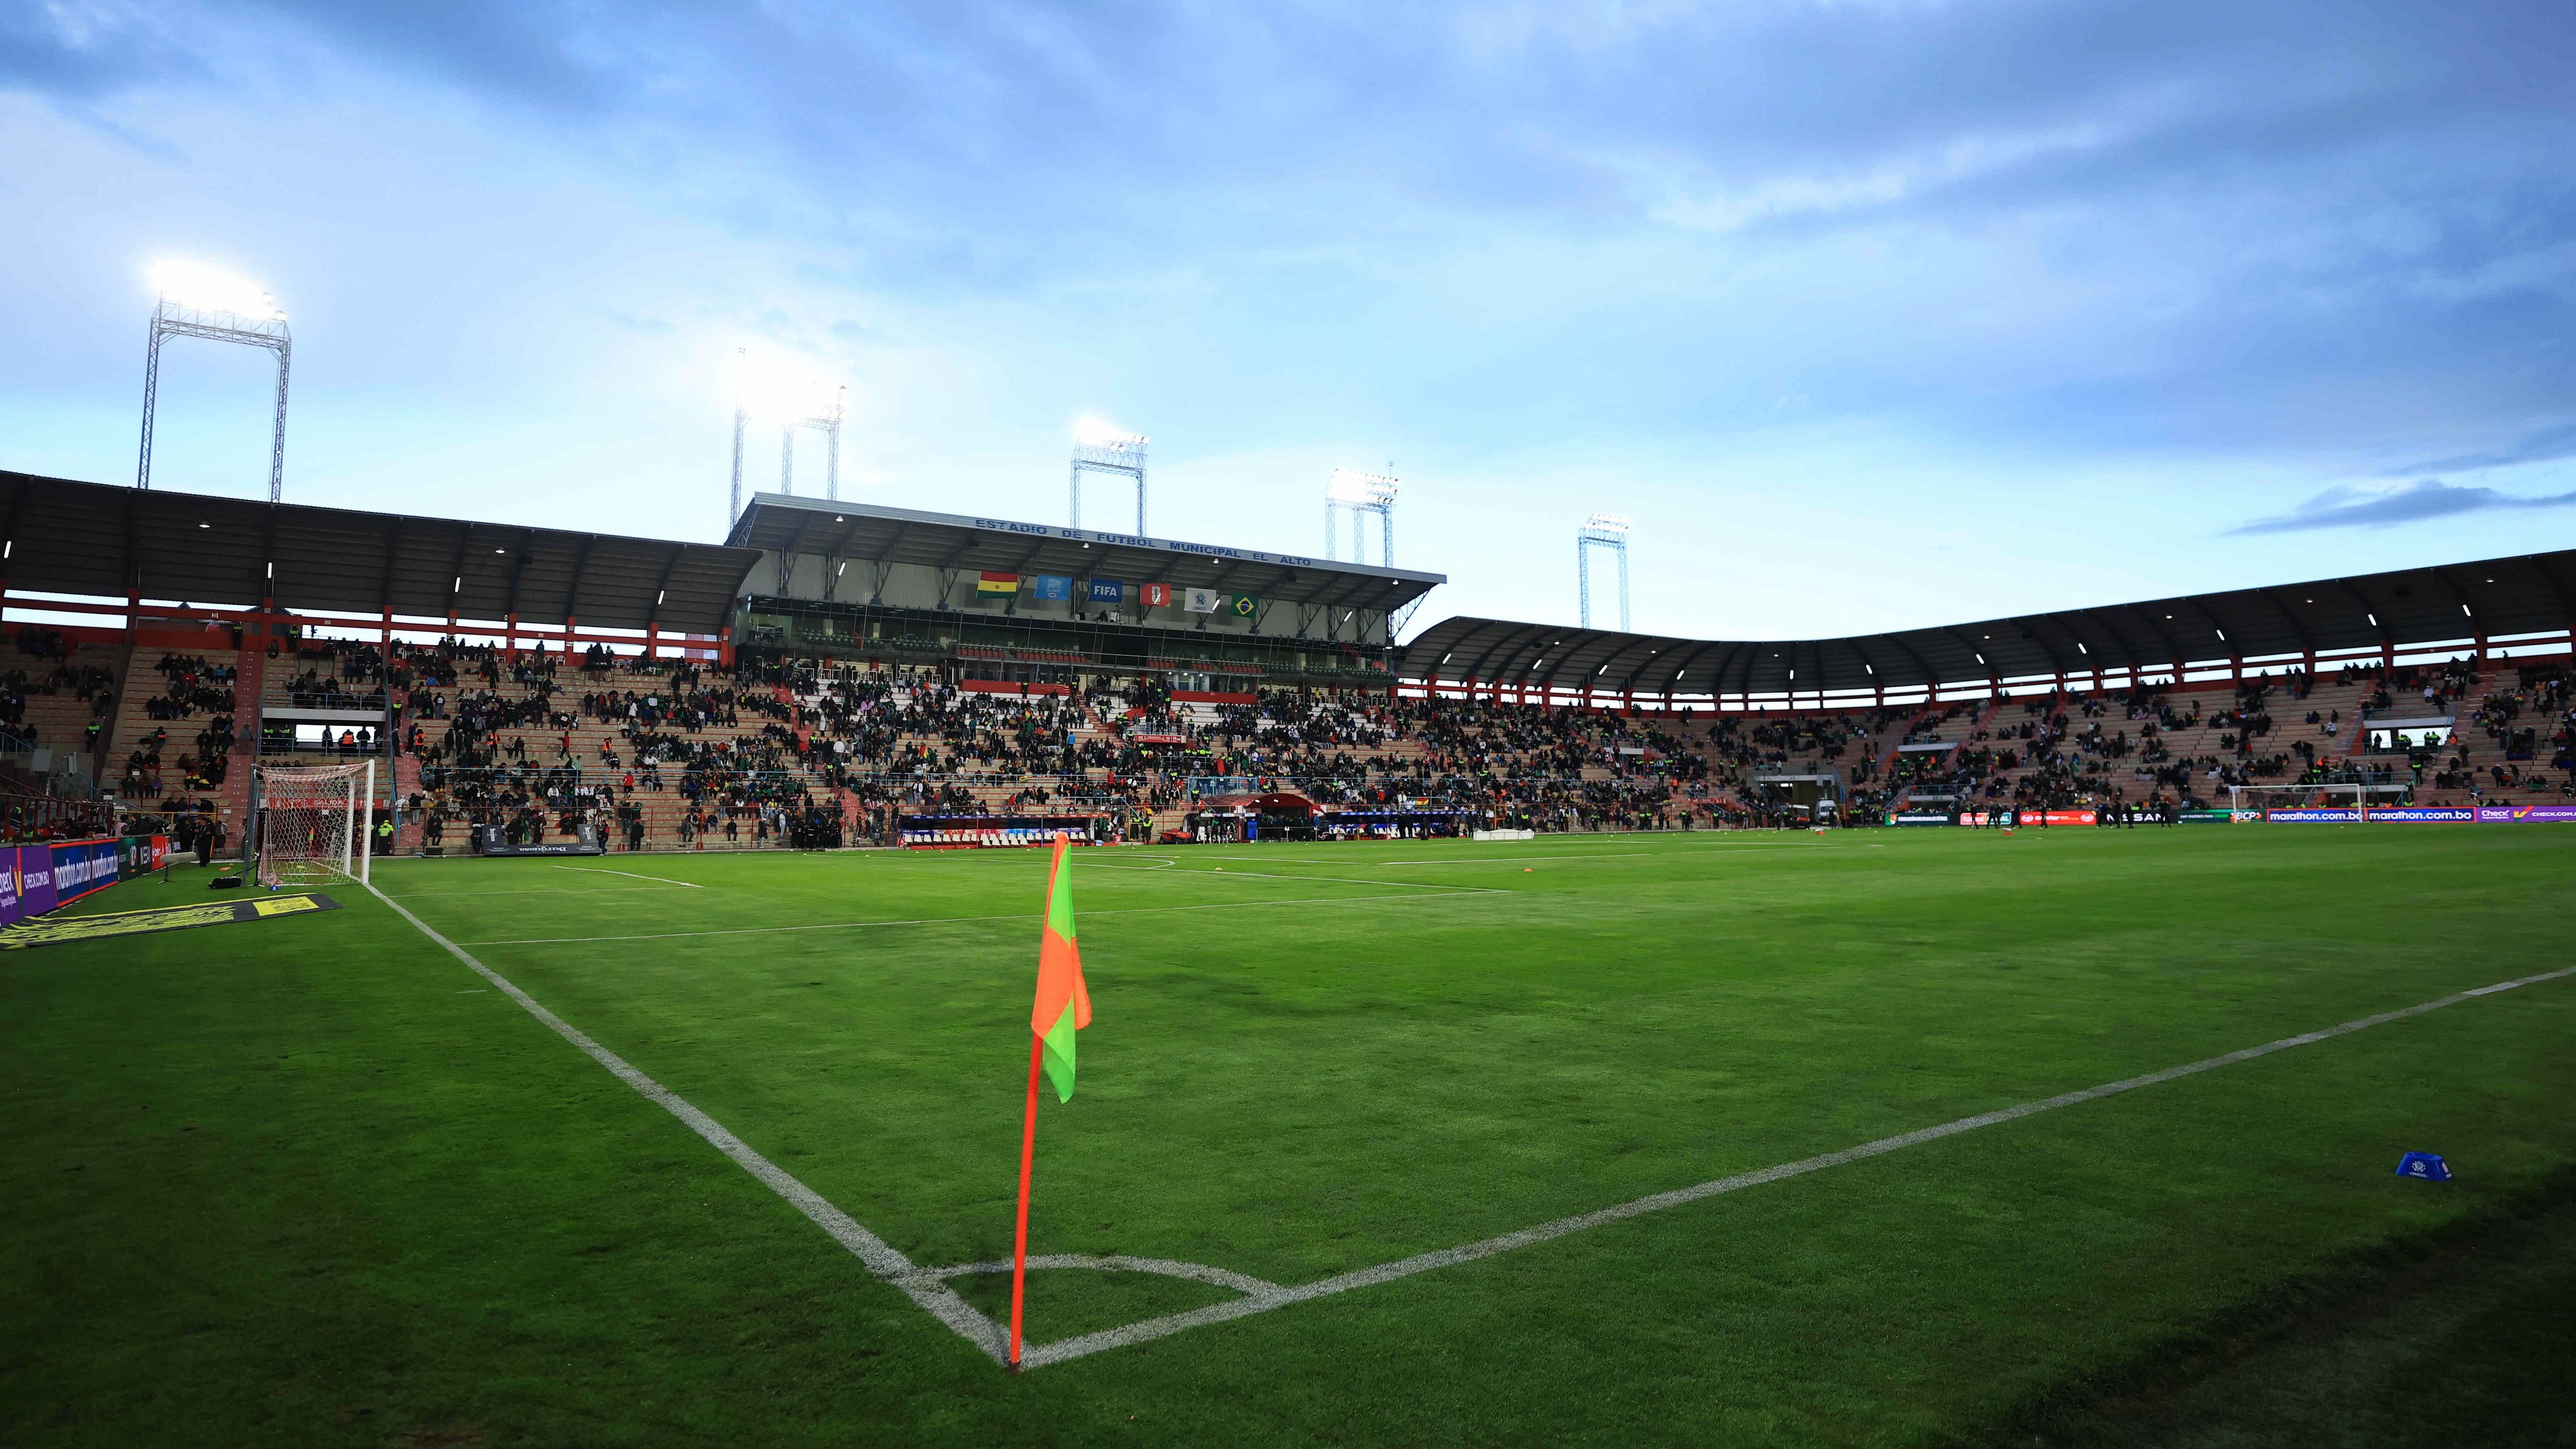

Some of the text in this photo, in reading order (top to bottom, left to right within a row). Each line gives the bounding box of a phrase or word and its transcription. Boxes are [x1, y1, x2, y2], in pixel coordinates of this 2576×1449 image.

[976, 519, 1311, 566] ESTADIO DE FUTBOL MUNICIPAL EL ALTO
[1094, 585, 1117, 597] FIFA
[2236, 812, 2257, 820] BCP
[2270, 812, 2363, 820] marathon.com.bo
[2369, 811, 2471, 820] marathon.com.bo
[54, 855, 91, 891] marathon.com.bo
[24, 870, 50, 889] CHECK.COM.BO
